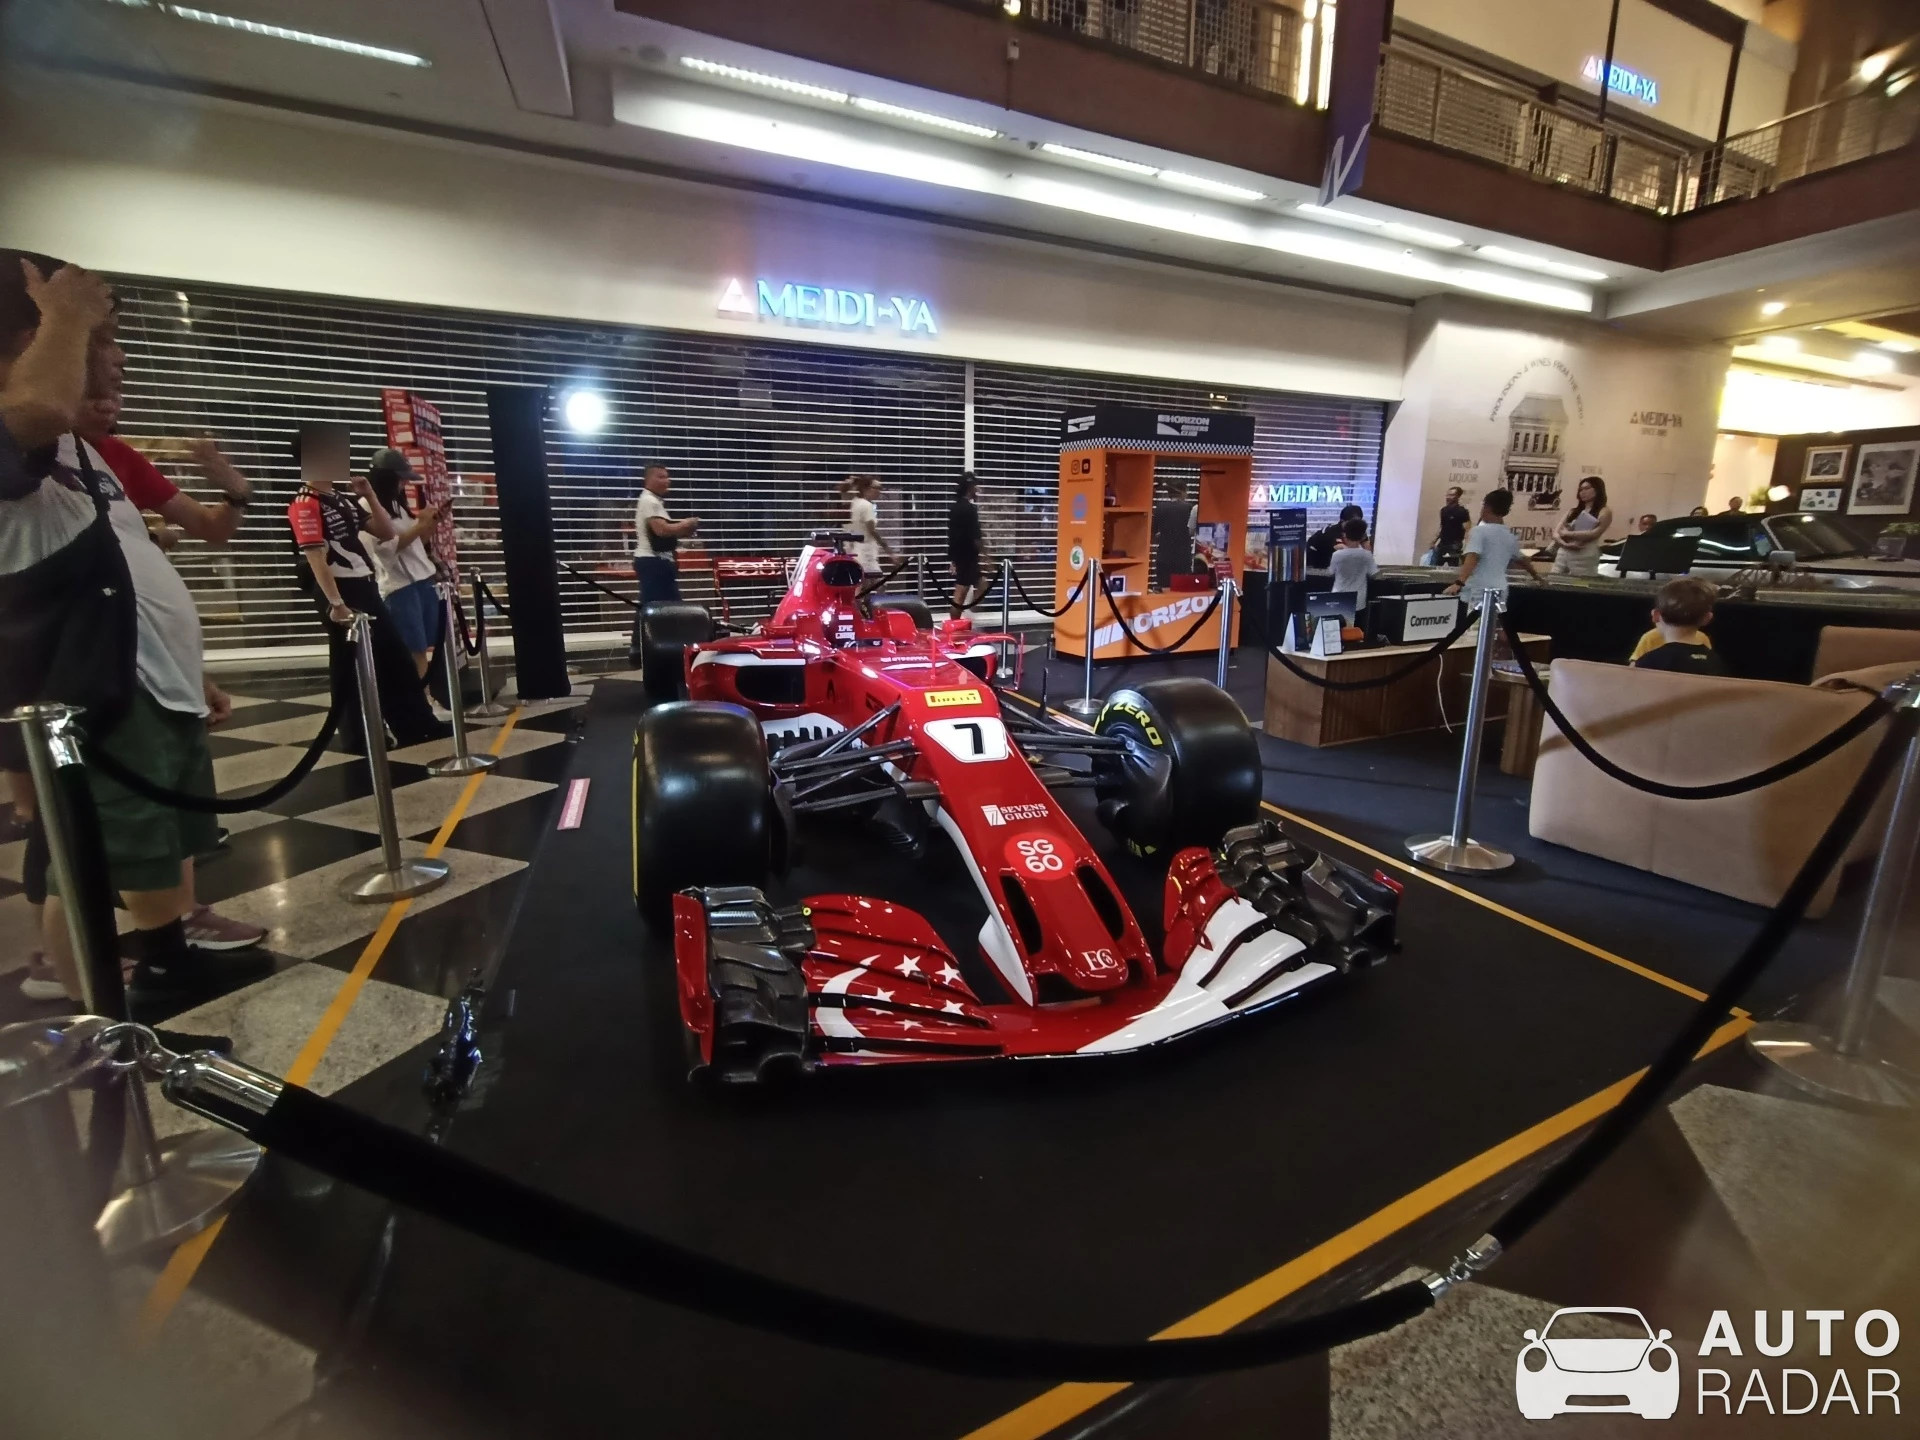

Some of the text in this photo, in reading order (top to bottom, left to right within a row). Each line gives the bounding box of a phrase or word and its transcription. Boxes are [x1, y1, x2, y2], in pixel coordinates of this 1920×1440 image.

[757, 279, 937, 334] MEIDI-YA
[1641, 411, 1682, 428] MEIDI-YA
[1452, 459, 1479, 469] WINE &
[1449, 473, 1478, 483] LIQUOR
[1268, 484, 1343, 503] MEIDI-YA
[1410, 614, 1449, 628] Commune
[1113, 702, 1163, 746] ZERO
[954, 723, 984, 755] 7
[1000, 803, 1047, 814] SEVENS
[1004, 810, 1049, 821] GROUP
[1017, 839, 1054, 856] SG
[1025, 854, 1063, 873] 60
